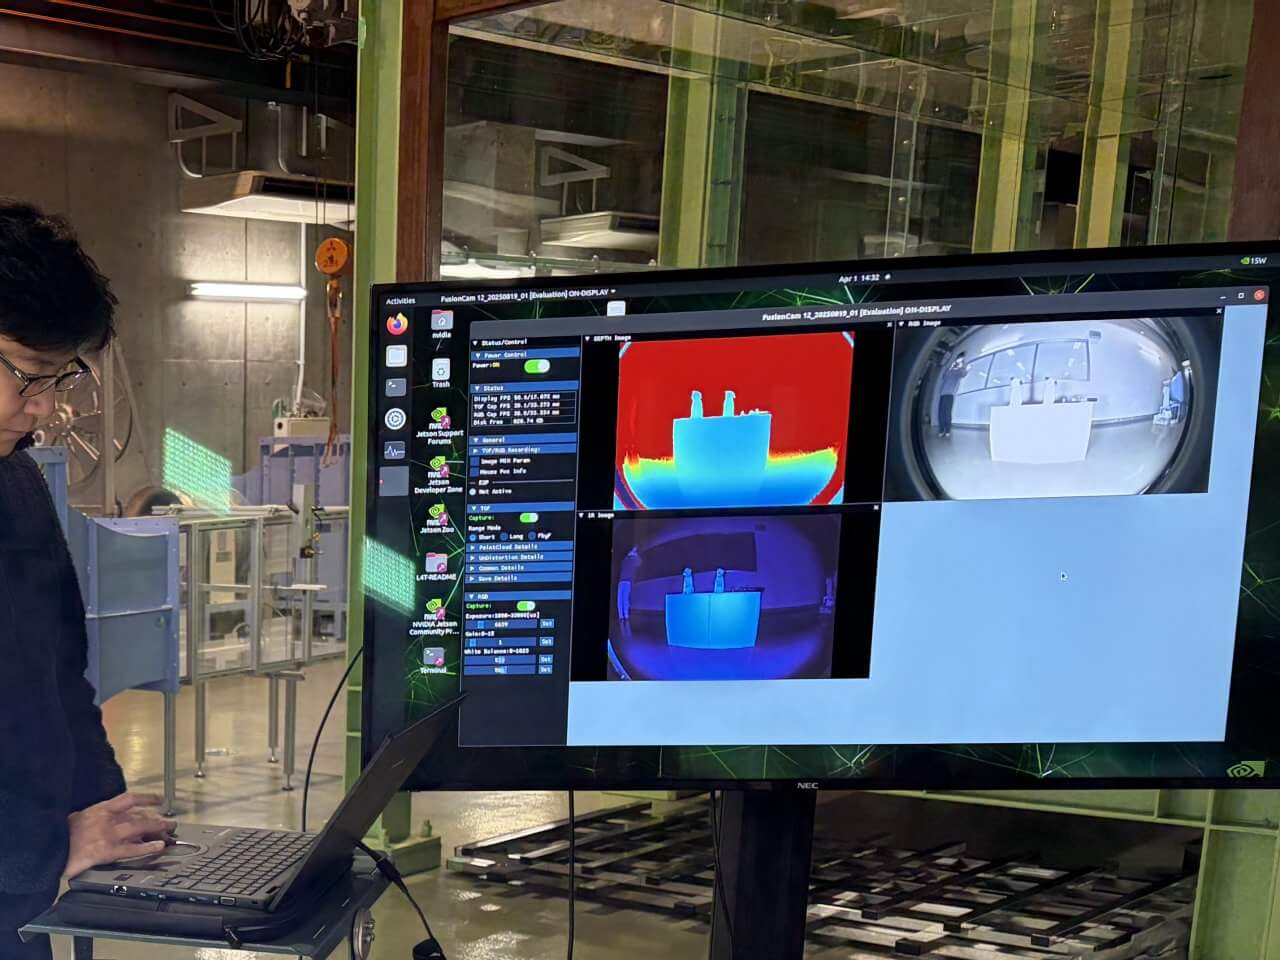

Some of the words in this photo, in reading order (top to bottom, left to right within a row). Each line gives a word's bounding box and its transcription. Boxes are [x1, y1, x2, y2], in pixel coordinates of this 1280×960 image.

[1251, 256, 1268, 265] 15W
[839, 275, 852, 283] Apr
[441, 295, 476, 303] FusionCam
[569, 289, 609, 297] ON-DISPLAY
[762, 313, 801, 321] FusionCam
[904, 305, 951, 313] ON-DISPLAY
[432, 331, 452, 339] nvidia
[438, 430, 464, 438] Support
[414, 487, 446, 495] Developer
[409, 629, 444, 637] Community
